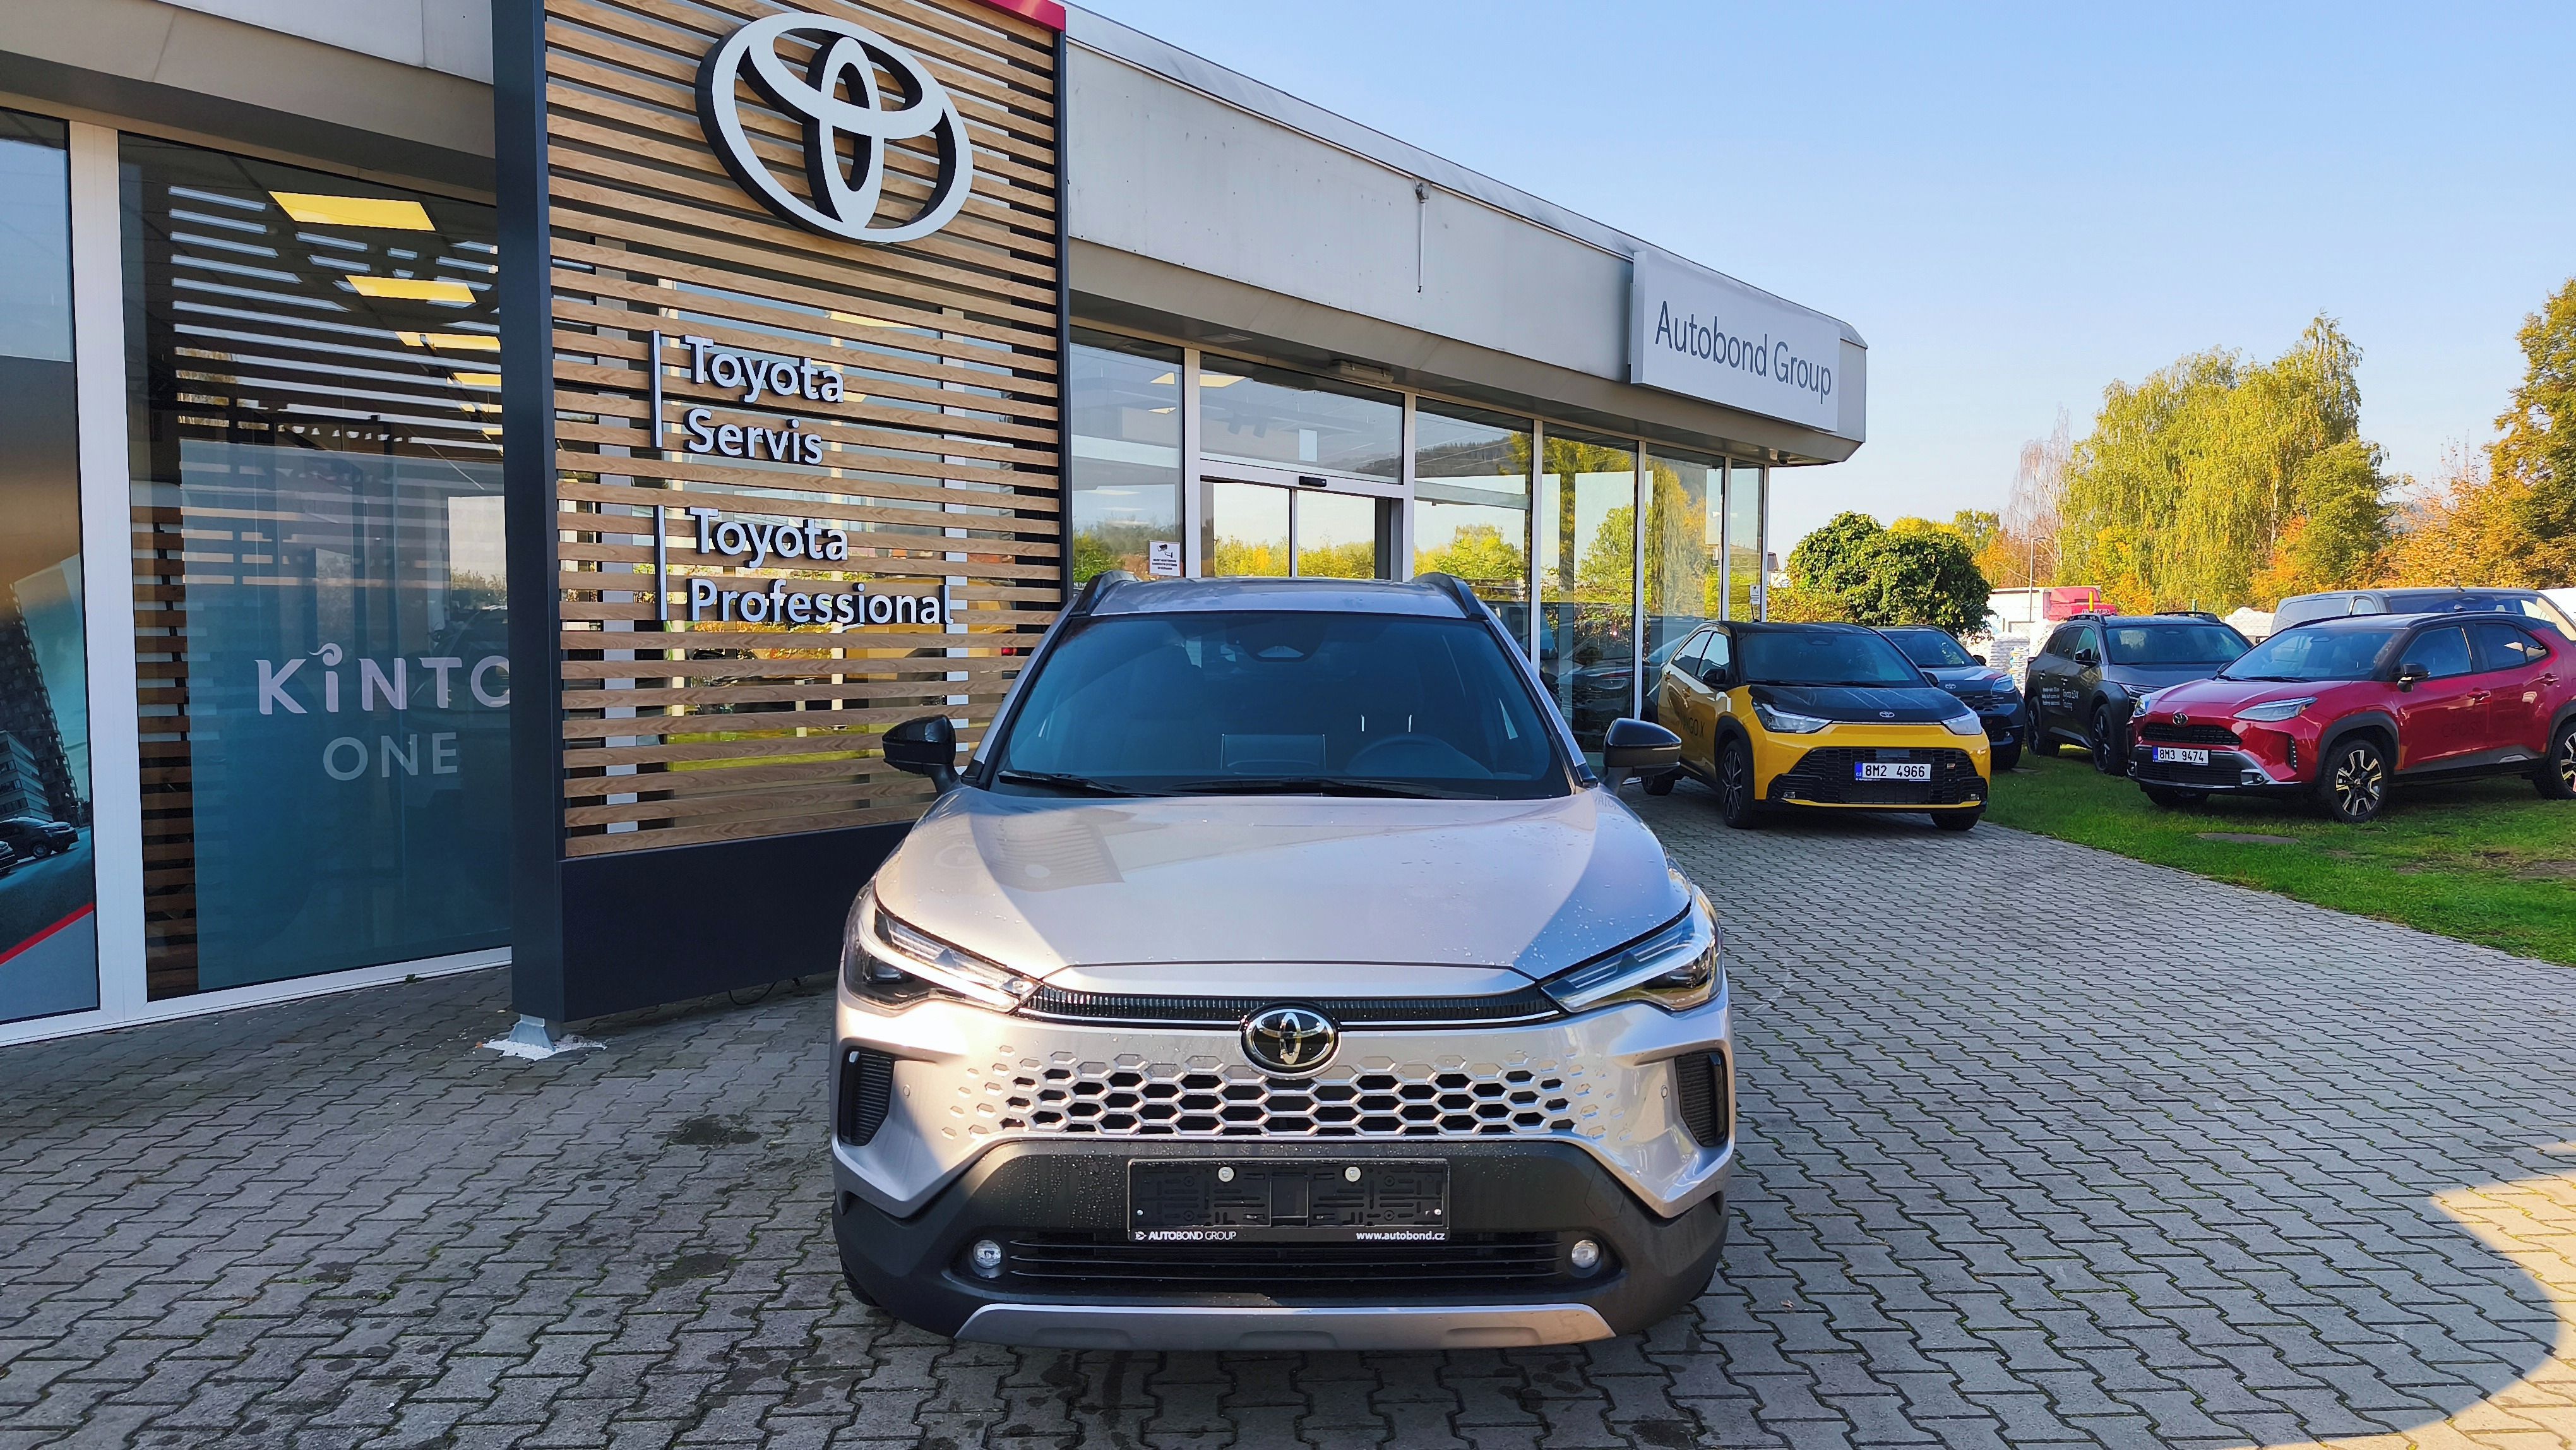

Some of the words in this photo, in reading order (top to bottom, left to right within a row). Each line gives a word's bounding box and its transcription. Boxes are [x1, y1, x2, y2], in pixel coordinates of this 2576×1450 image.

[682, 335, 844, 403] Toyota
[1655, 301, 1767, 377] Autobond
[1774, 341, 1832, 405] Group
[684, 409, 823, 464] Servis
[686, 507, 849, 568] Toyota
[687, 578, 954, 625] Professional
[323, 733, 458, 781] ONE
[1865, 765, 1887, 777] 8M2
[1896, 765, 1925, 777] 4966
[2159, 749, 2176, 760] 8M3
[2182, 750, 2203, 762] 9474
[1148, 1231, 1203, 1240] AUTOBOND
[1205, 1231, 1237, 1240] GROUP
[1356, 1230, 1445, 1240] www.autobond.cz
